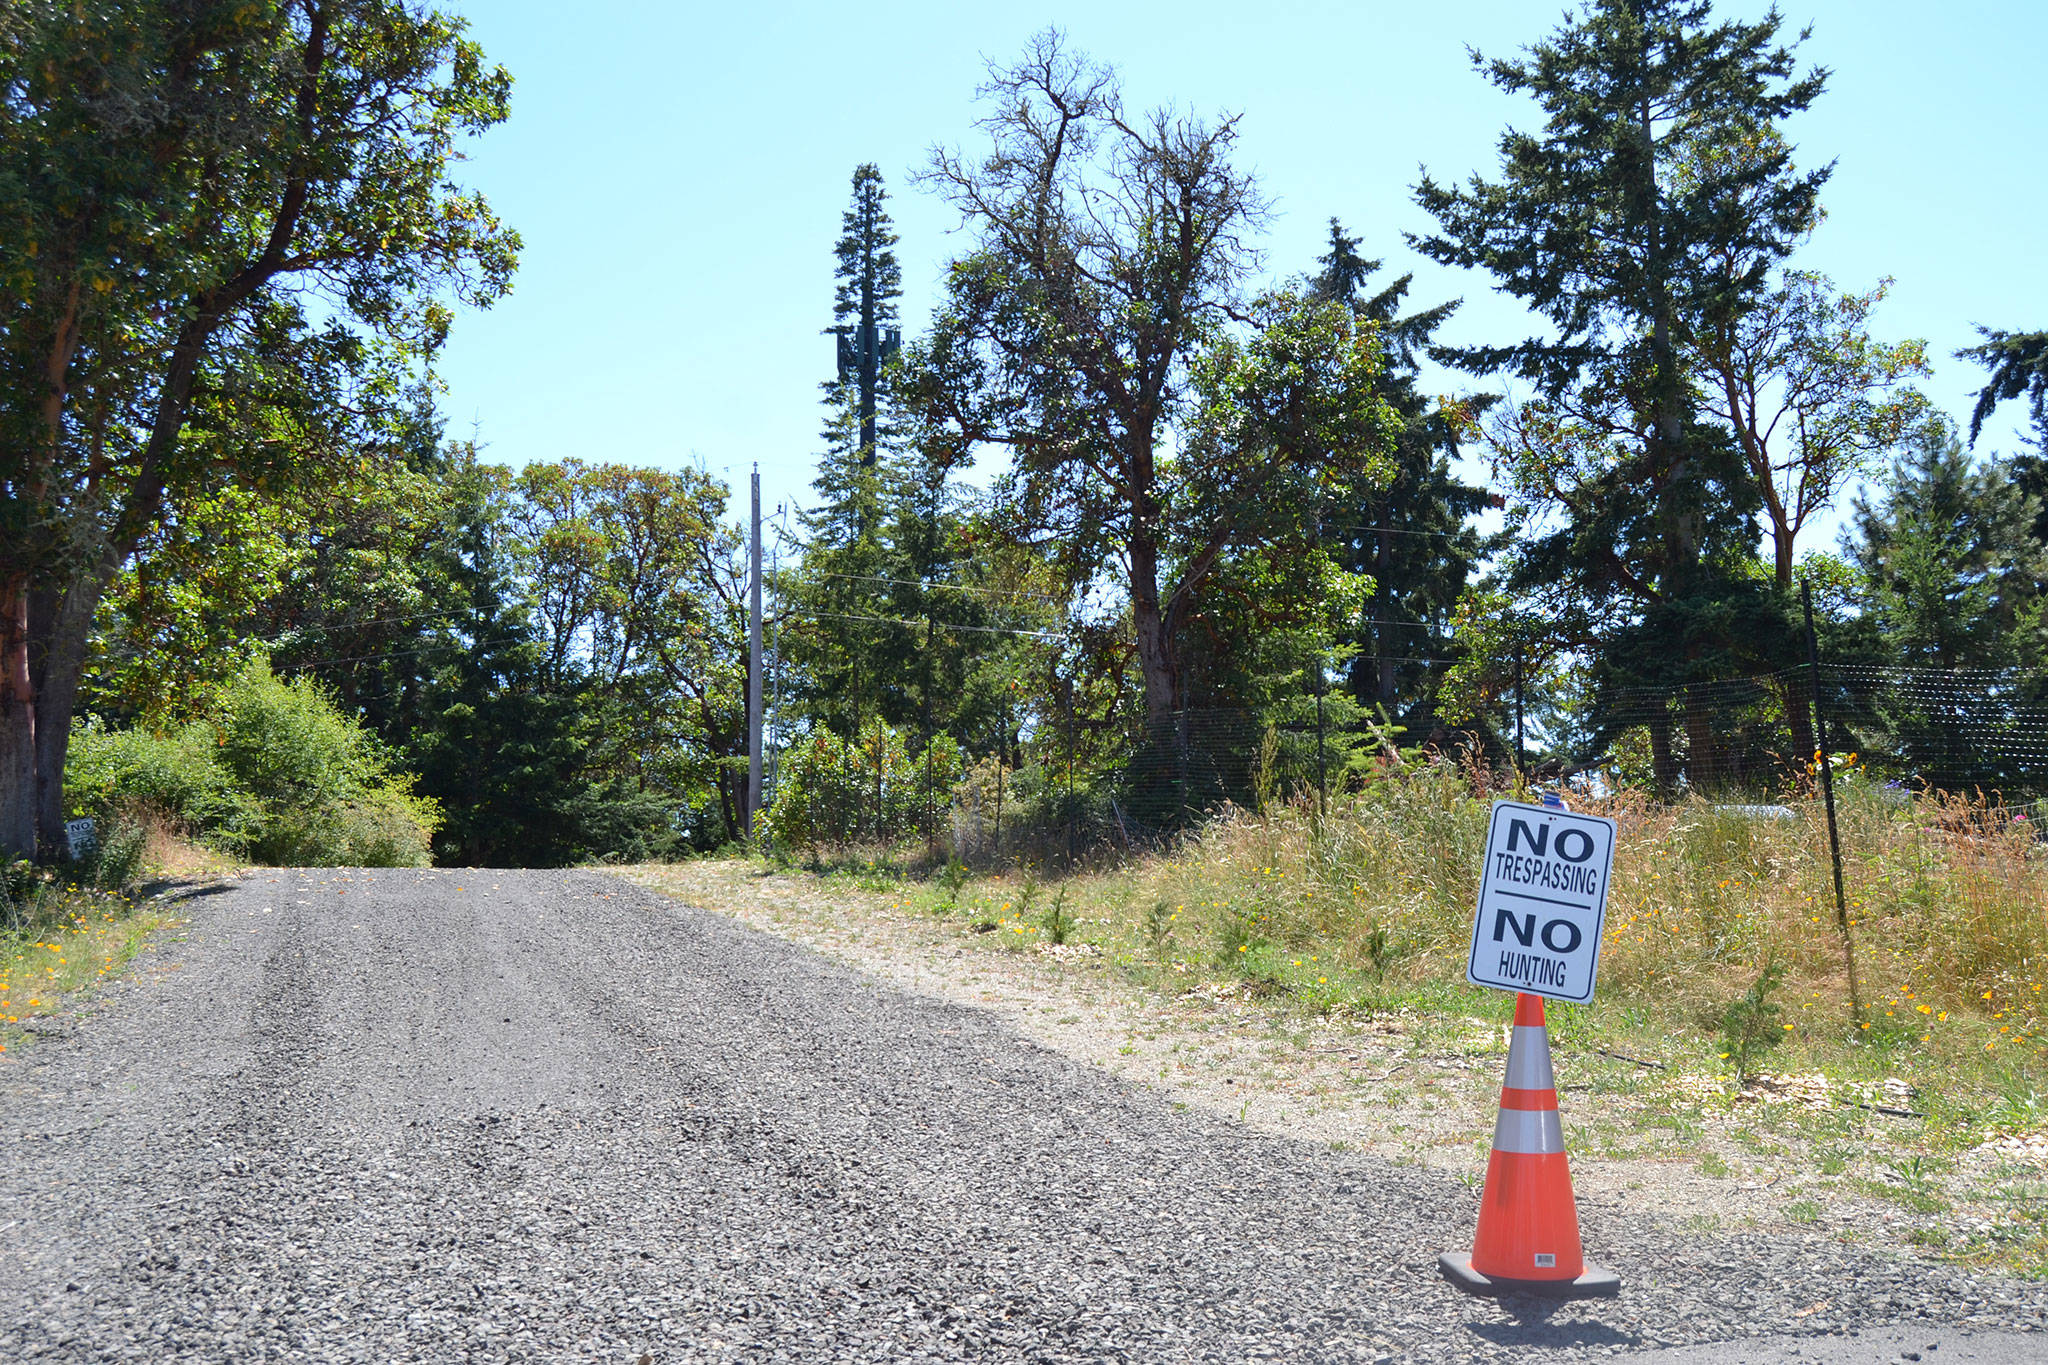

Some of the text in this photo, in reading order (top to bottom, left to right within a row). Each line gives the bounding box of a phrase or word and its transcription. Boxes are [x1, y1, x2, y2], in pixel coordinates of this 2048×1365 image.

[71, 822, 90, 832] NO
[1506, 818, 1595, 863] NO
[1496, 852, 1597, 896] TRESPASSING
[1493, 908, 1582, 954] NO
[1498, 950, 1567, 988] HUNTING
